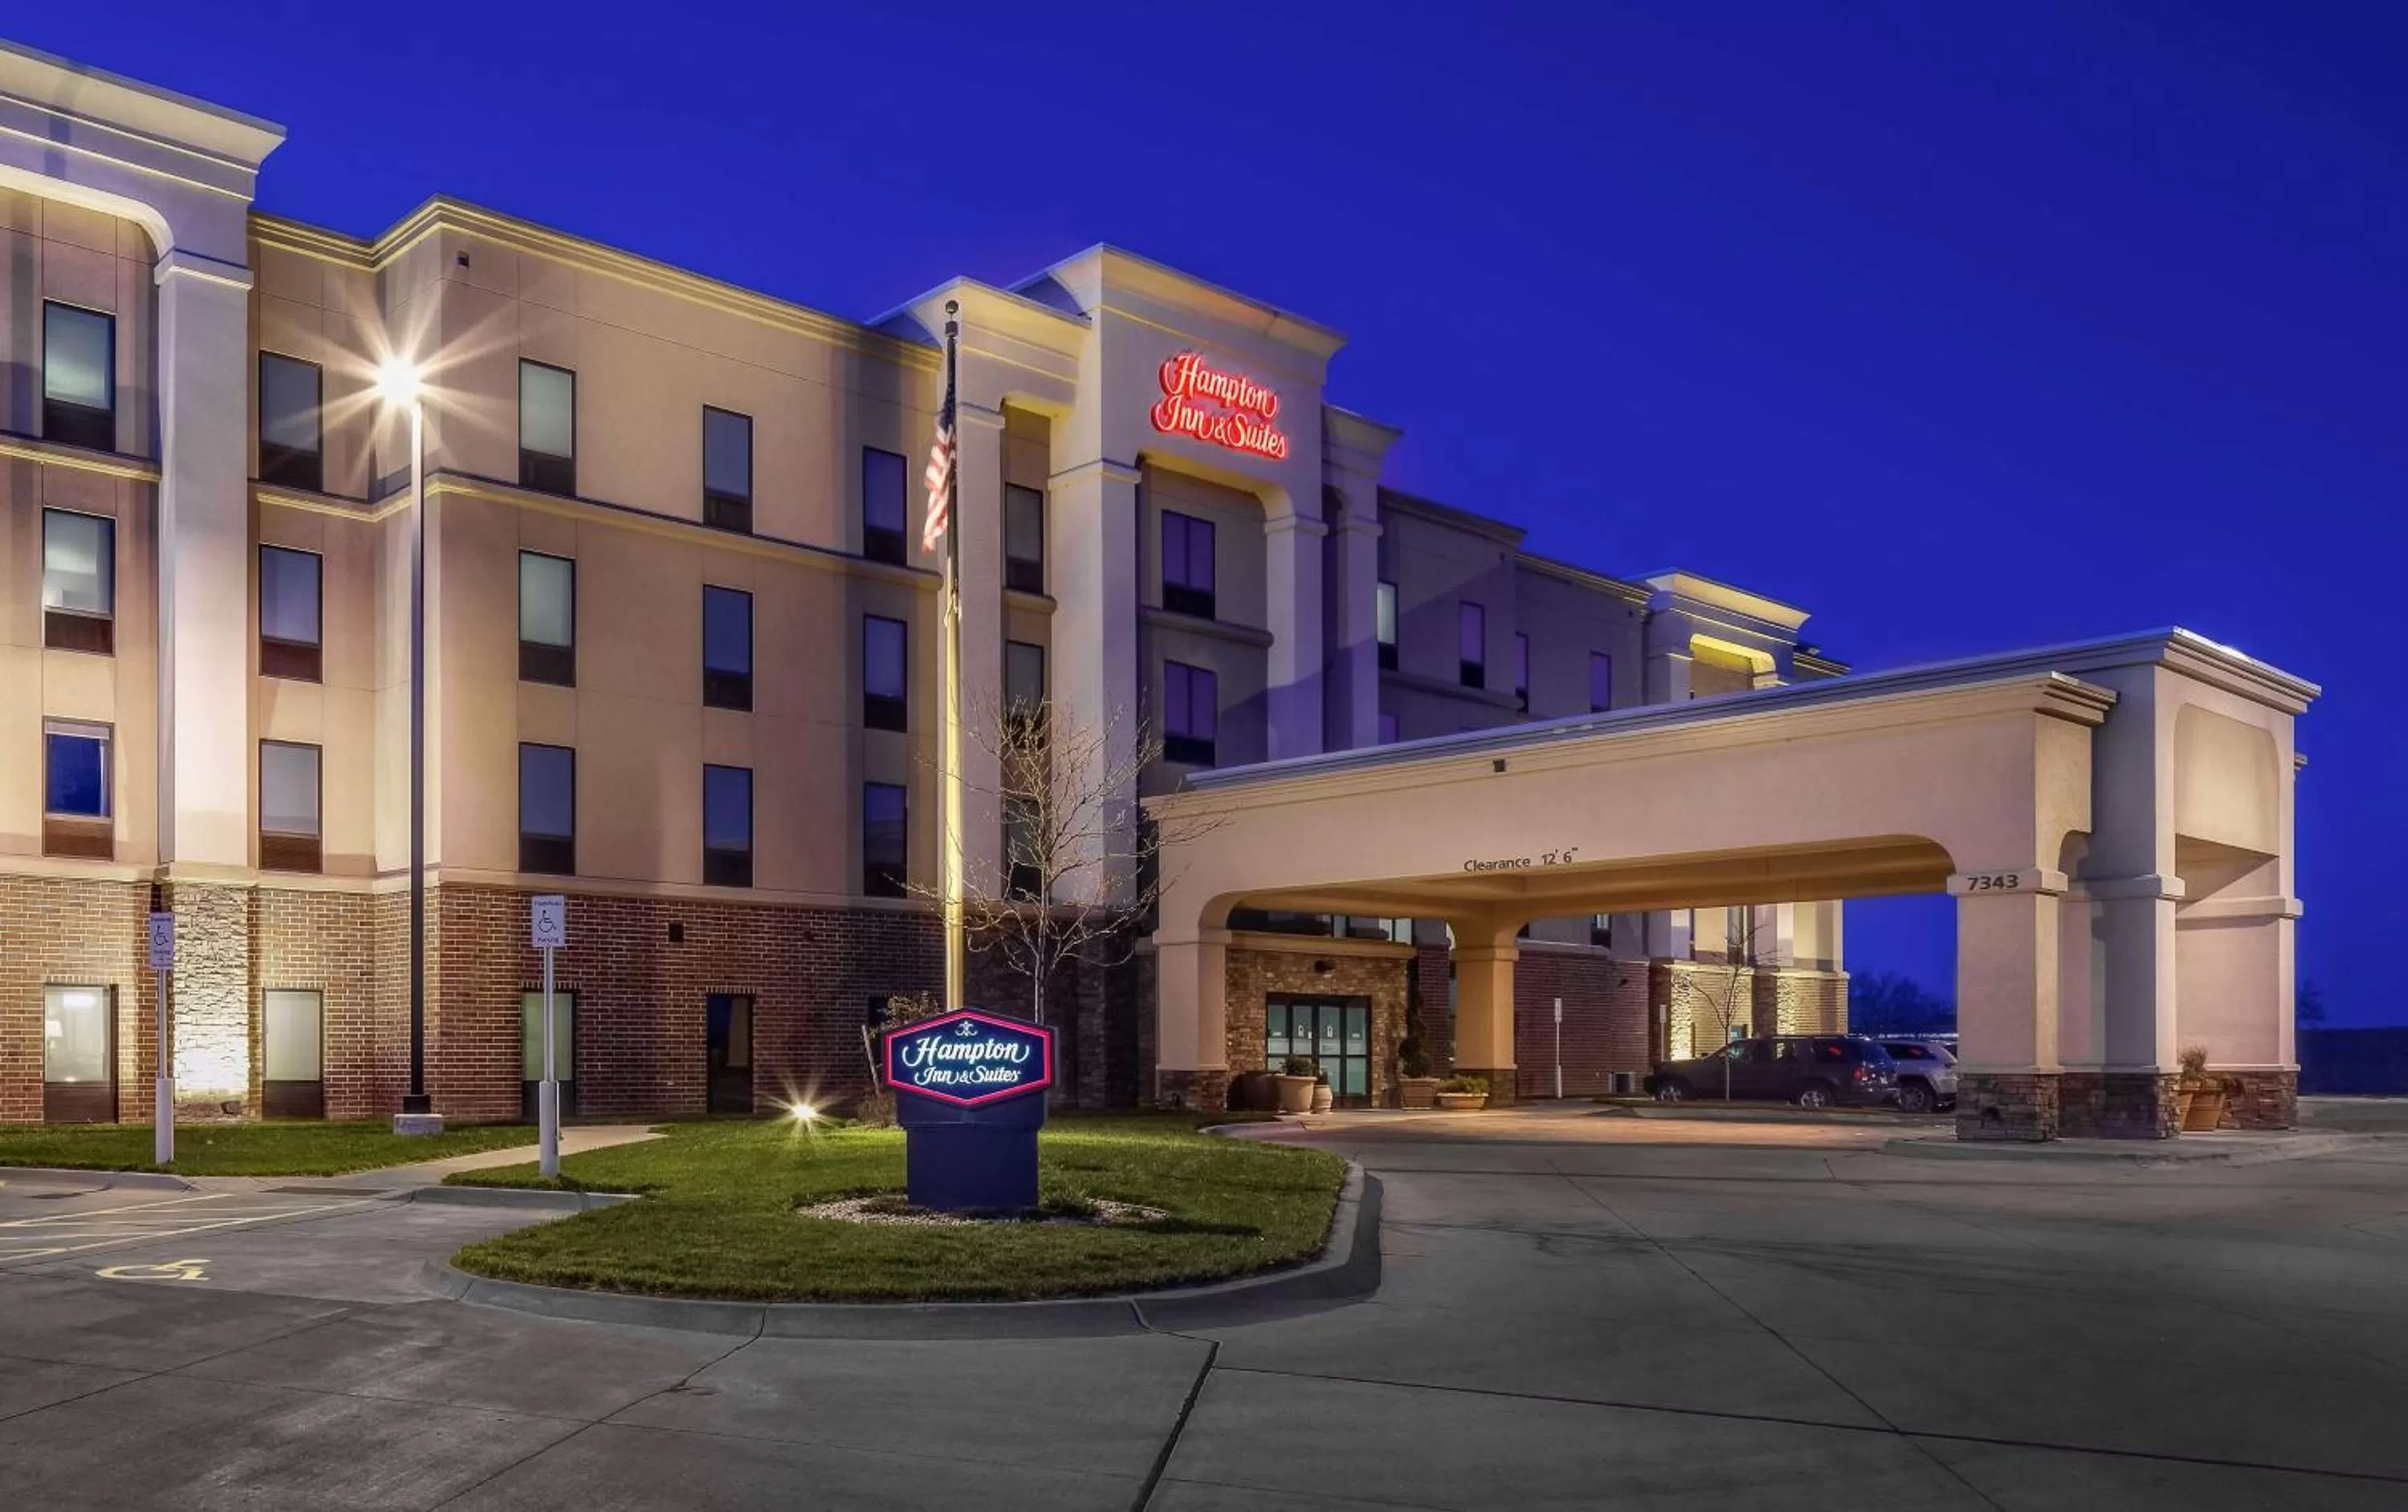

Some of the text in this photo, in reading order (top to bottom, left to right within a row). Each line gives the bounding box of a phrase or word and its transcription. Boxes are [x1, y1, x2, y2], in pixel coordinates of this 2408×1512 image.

[1160, 352, 1279, 421] Hampton
[1152, 393, 1216, 440] Inn
[1226, 412, 1287, 459] Suites
[1463, 857, 1531, 872] Clearance
[1967, 874, 2019, 891] 7343
[901, 1035, 1030, 1067] Hampton
[914, 1067, 960, 1086] Inn
[969, 1065, 1020, 1083] Suites
